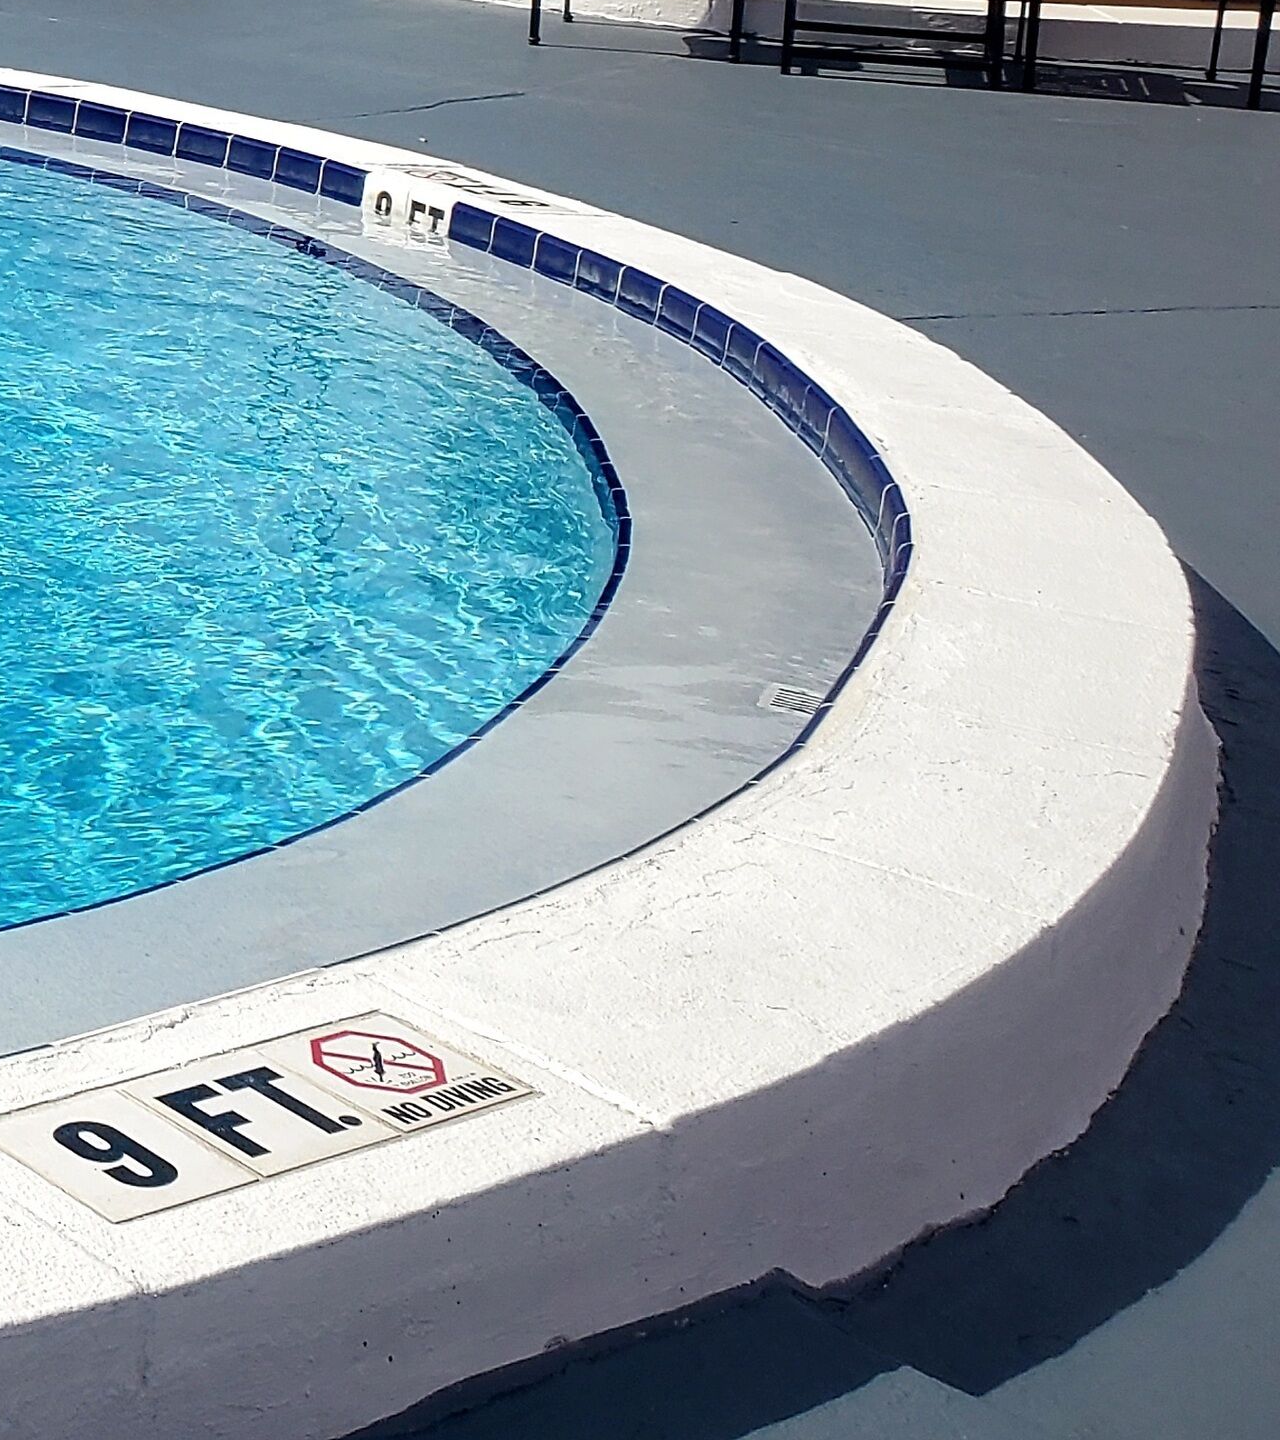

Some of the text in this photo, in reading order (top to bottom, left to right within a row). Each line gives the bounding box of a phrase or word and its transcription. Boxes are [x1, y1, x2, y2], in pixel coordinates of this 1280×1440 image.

[407, 199, 446, 234] FT
[381, 1076, 518, 1125] NO DIVING
[52, 1065, 363, 1188] 9 FT.
